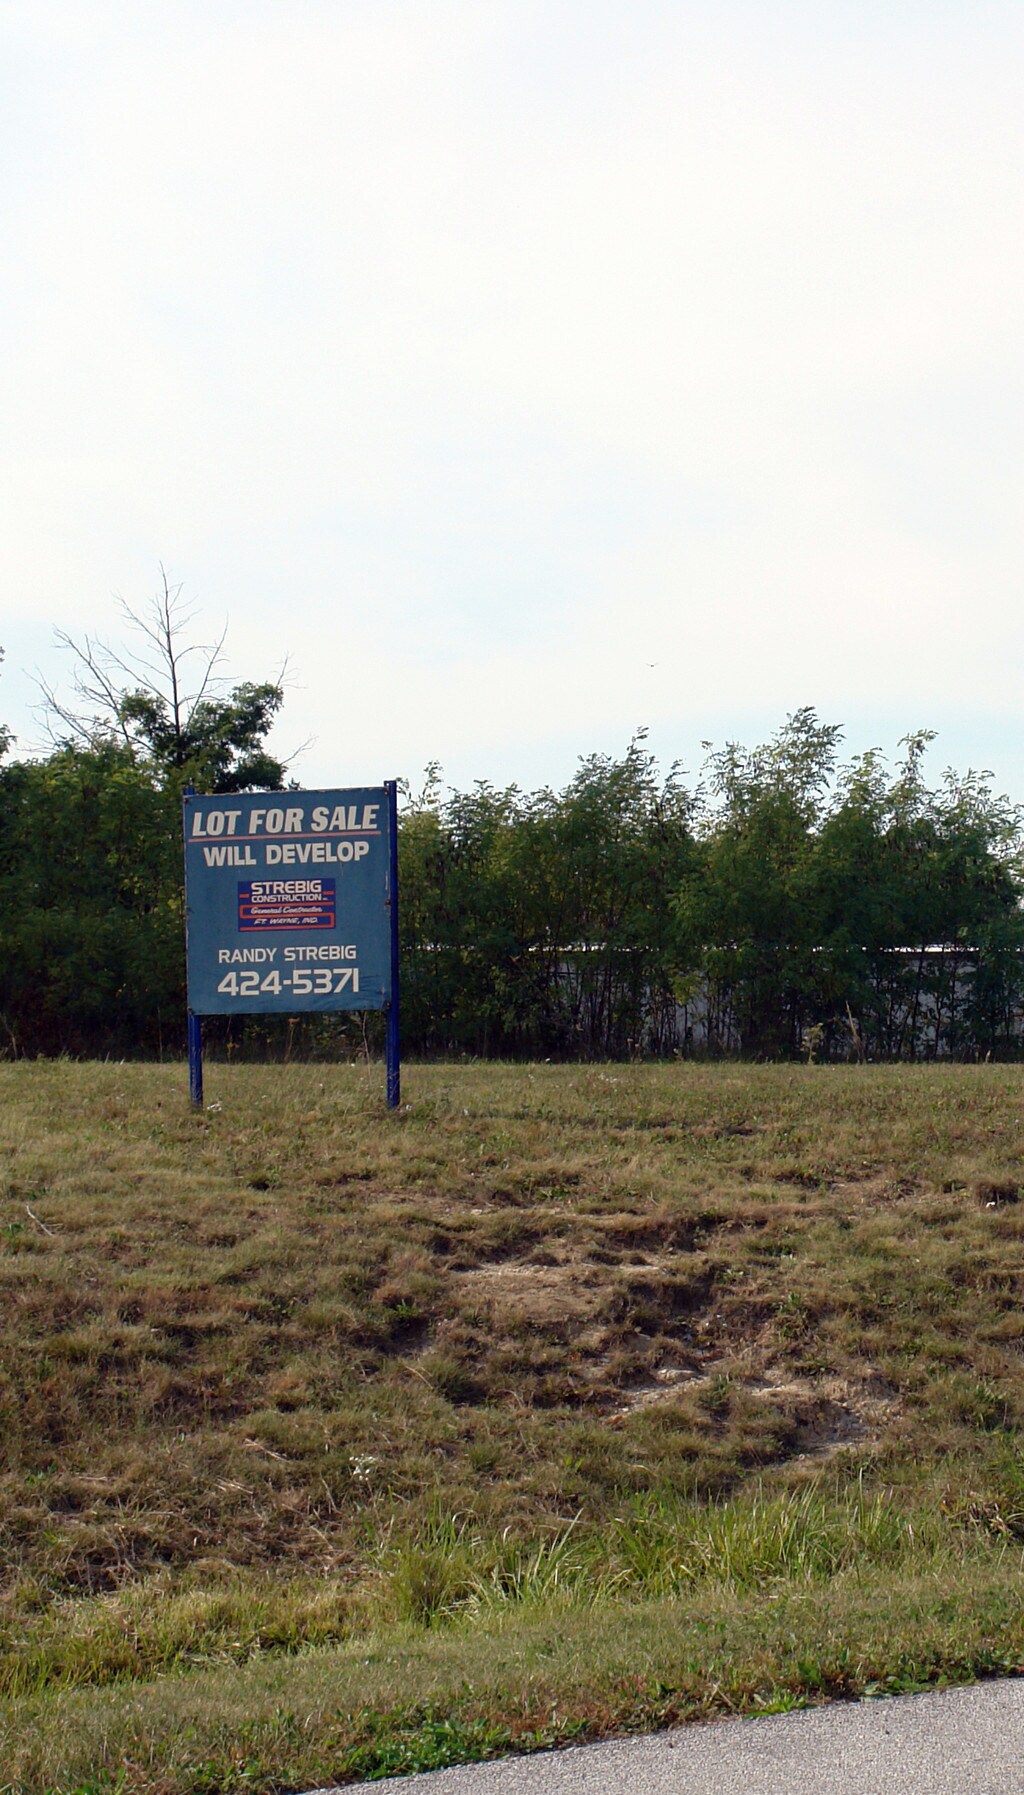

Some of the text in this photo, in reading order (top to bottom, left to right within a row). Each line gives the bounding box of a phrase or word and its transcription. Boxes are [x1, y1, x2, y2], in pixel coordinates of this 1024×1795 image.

[192, 804, 380, 837] LOT FOR SALE
[203, 841, 370, 867] WILL DEVELOP
[250, 880, 322, 895] STREBIG
[251, 894, 322, 903] CONSTRUCTION
[250, 906, 282, 914] General
[218, 945, 357, 963] RANDY STREBIG
[217, 968, 359, 996] 424-5371
